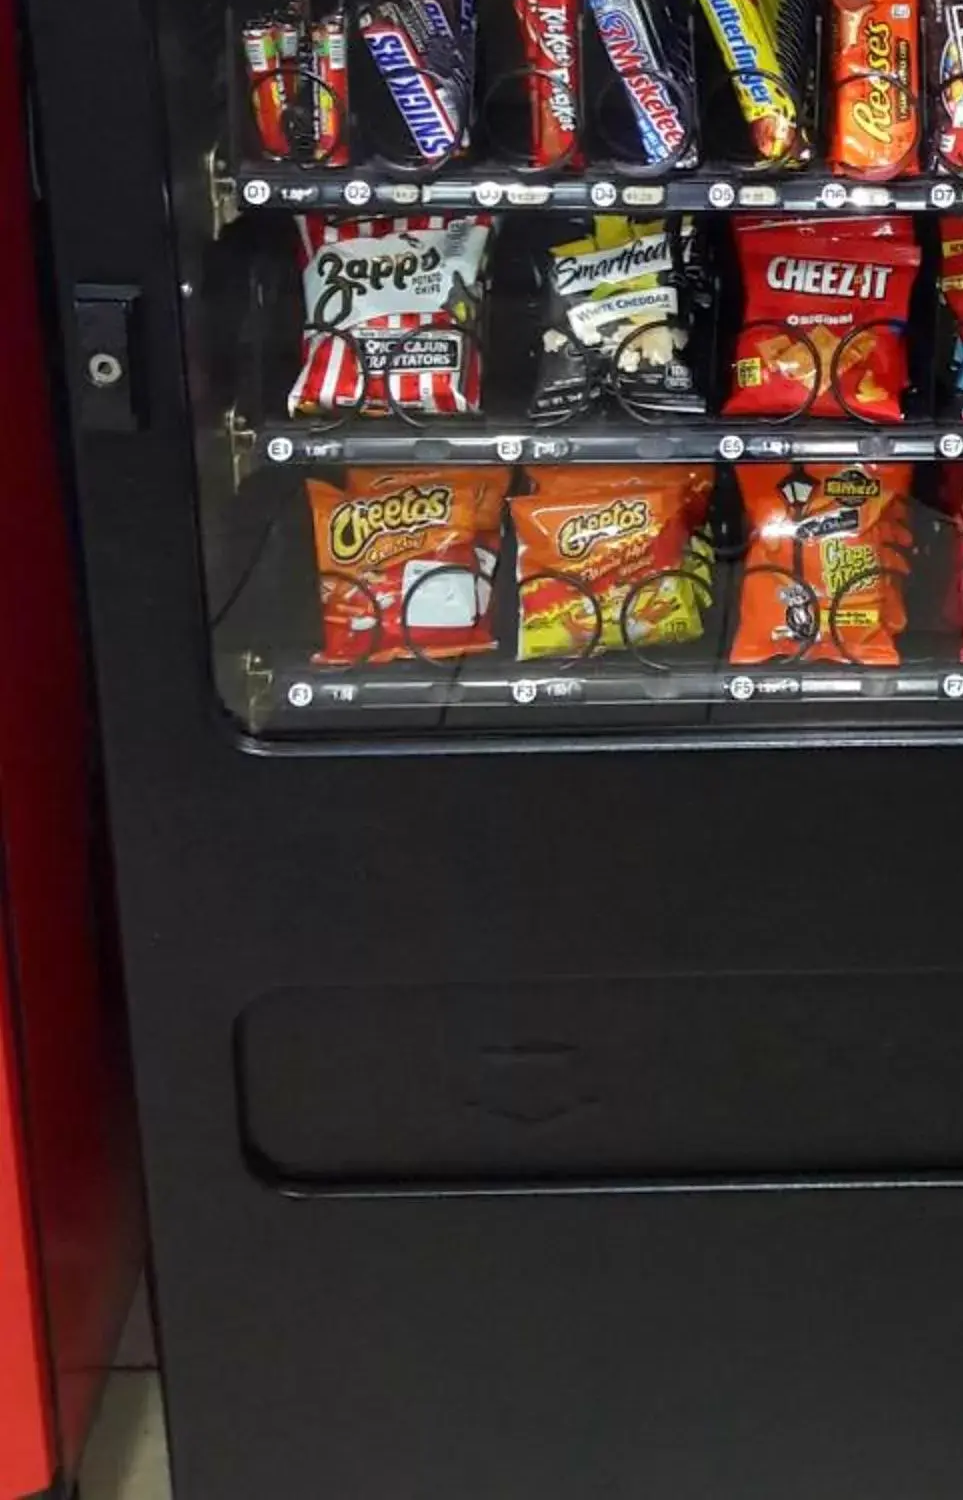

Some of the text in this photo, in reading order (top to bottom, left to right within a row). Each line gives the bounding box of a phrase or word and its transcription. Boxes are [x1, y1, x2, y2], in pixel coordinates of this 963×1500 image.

[853, 20, 892, 144] Reese's
[366, 31, 452, 157] SNICKERS
[245, 183, 267, 198] D1
[346, 184, 369, 200] D2
[594, 186, 615, 200] D4
[711, 187, 732, 202] D5
[934, 187, 954, 201] D7
[554, 238, 673, 291] Smartfood
[412, 272, 442, 285] POTATO
[415, 284, 441, 295] CHIPS
[615, 294, 669, 311] CHEDDAR
[403, 341, 449, 353] CAJUN
[943, 438, 962, 452] E7
[332, 486, 450, 558] Cheetos
[558, 500, 648, 557] Cheetos
